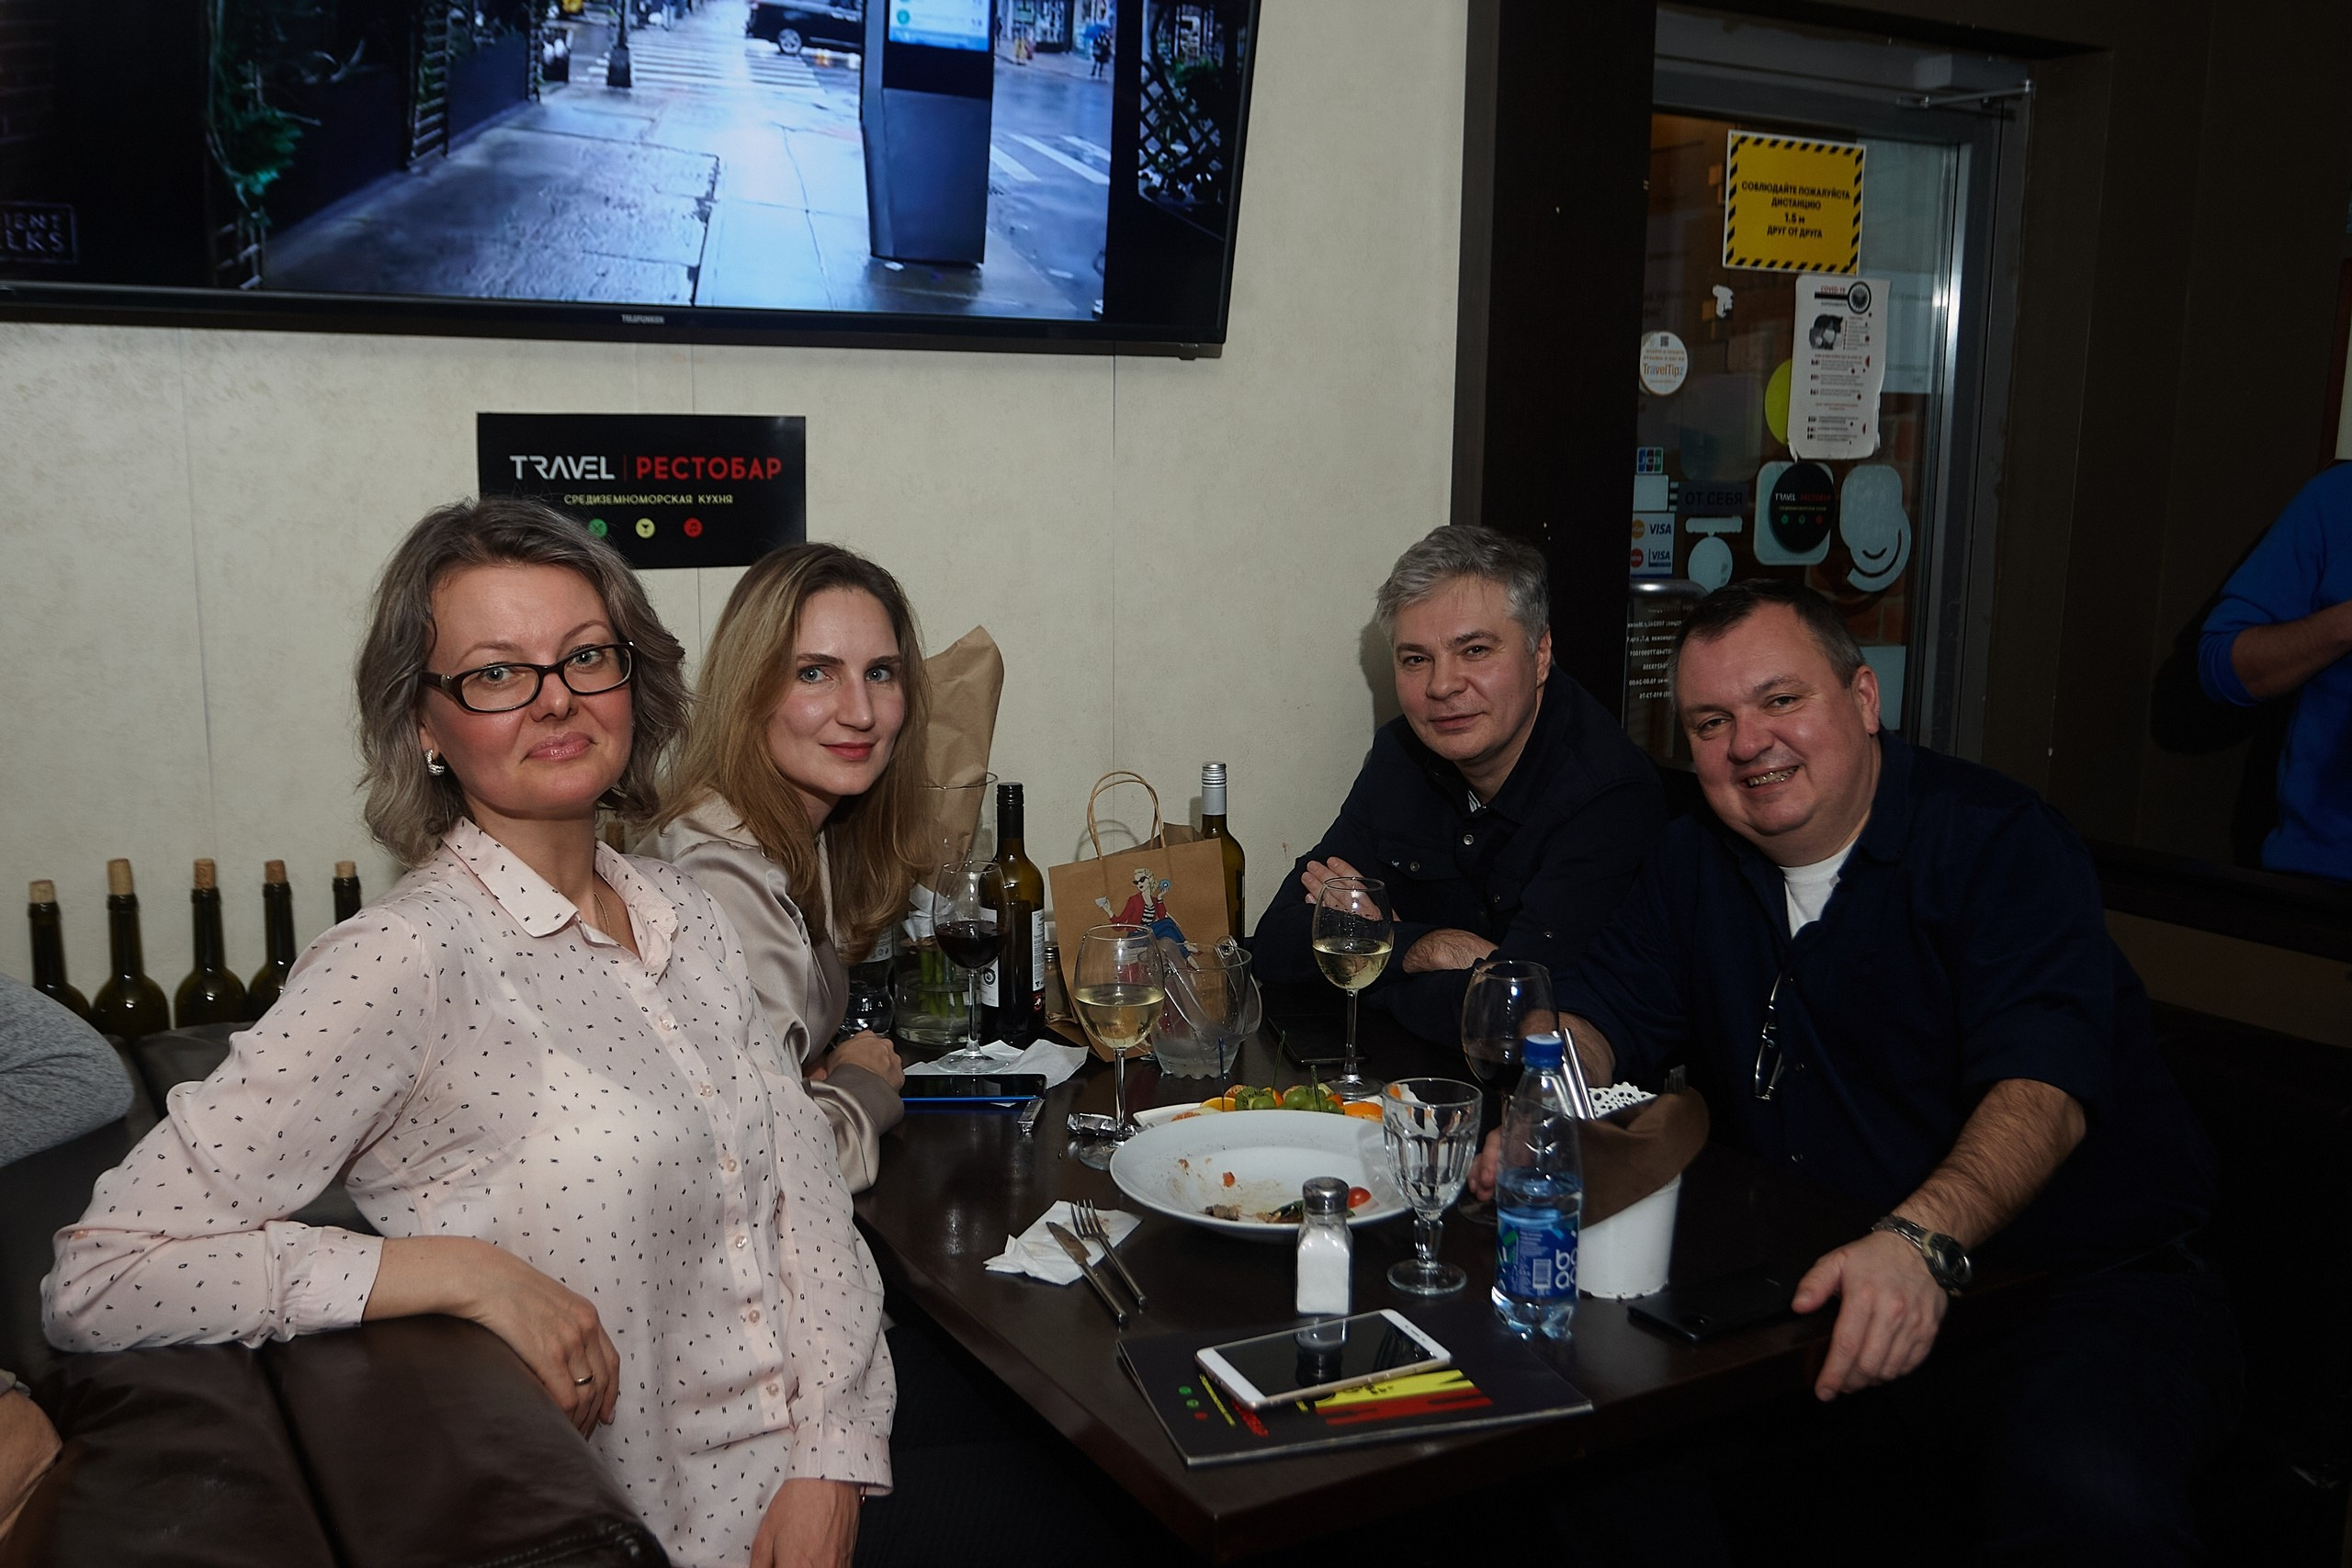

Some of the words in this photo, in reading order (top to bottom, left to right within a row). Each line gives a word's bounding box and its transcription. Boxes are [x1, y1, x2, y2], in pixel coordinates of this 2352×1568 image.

[1741, 181, 1797, 195] СОБЛЮДАЙТЕ
[1798, 185, 1850, 200] ПОЖАЛУЙСТА
[1771, 197, 1821, 210] ДИСТАНЦИЮ
[1767, 225, 1786, 235] ДРУГ
[1788, 227, 1798, 236] ОТ
[1800, 228, 1823, 239] ДРУГА
[0, 229, 65, 253] LKS
[509, 455, 616, 480] TRAVEL
[636, 457, 781, 480] РЕСТОБАР
[563, 493, 693, 505] СРЕДИЗЕМНОМОРСКАЯ
[698, 494, 733, 505] КУХНЯ
[1685, 491, 1704, 506] ОТ
[1707, 491, 1743, 506] СЕБЯ
[1649, 523, 1672, 536] VISA
[1651, 550, 1670, 561] VISA
